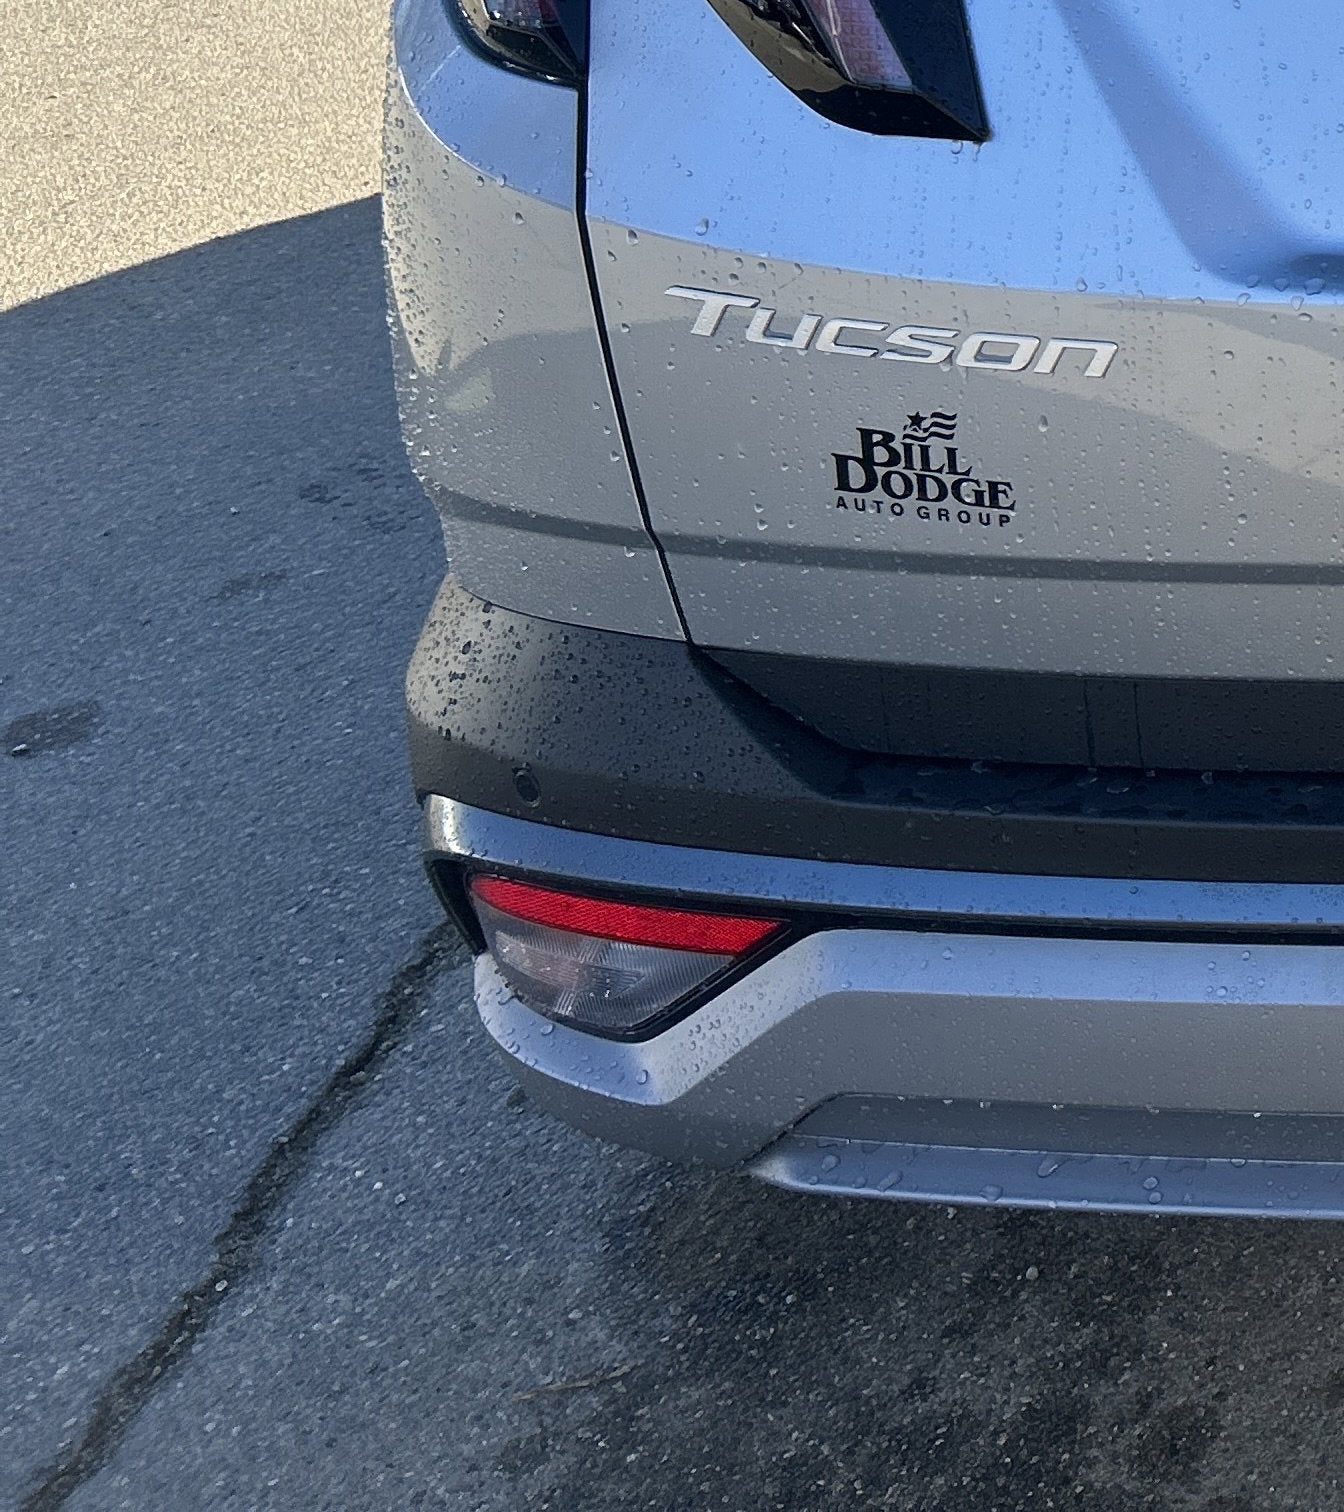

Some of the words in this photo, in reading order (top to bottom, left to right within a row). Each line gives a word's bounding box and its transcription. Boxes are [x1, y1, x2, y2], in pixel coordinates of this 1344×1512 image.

[855, 426, 973, 477] BILL
[830, 452, 1017, 512] DODGE
[835, 495, 905, 518] AUTO
[916, 505, 1012, 528] GROUP
